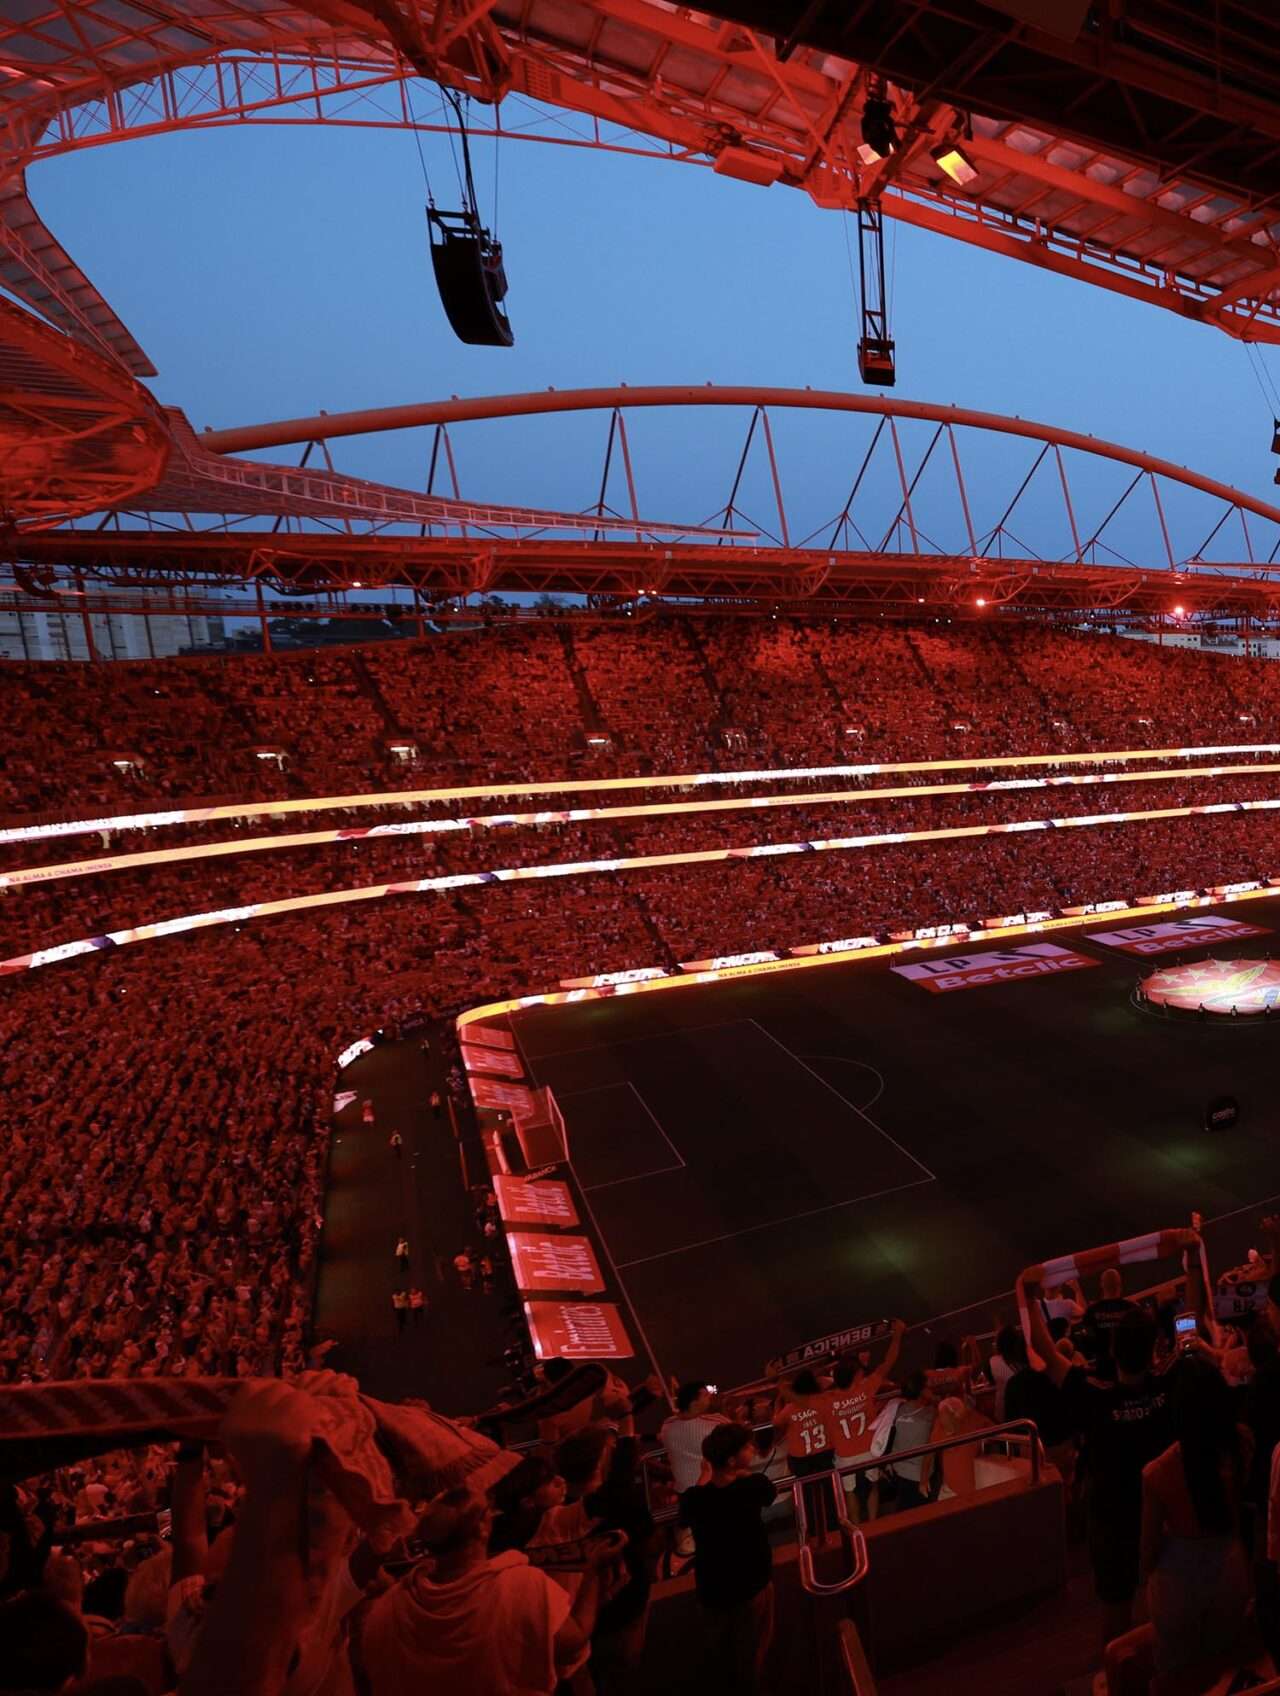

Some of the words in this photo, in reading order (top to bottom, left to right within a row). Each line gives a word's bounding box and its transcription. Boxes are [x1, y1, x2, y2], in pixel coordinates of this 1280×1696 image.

[1133, 925, 1262, 953] Betclic
[921, 958, 972, 974] LP
[934, 957, 1086, 990] Betclic
[521, 1241, 595, 1281] Betclic
[553, 1304, 617, 1353] Emirates
[800, 1423, 827, 1455] 13
[840, 1411, 866, 1440] 17
